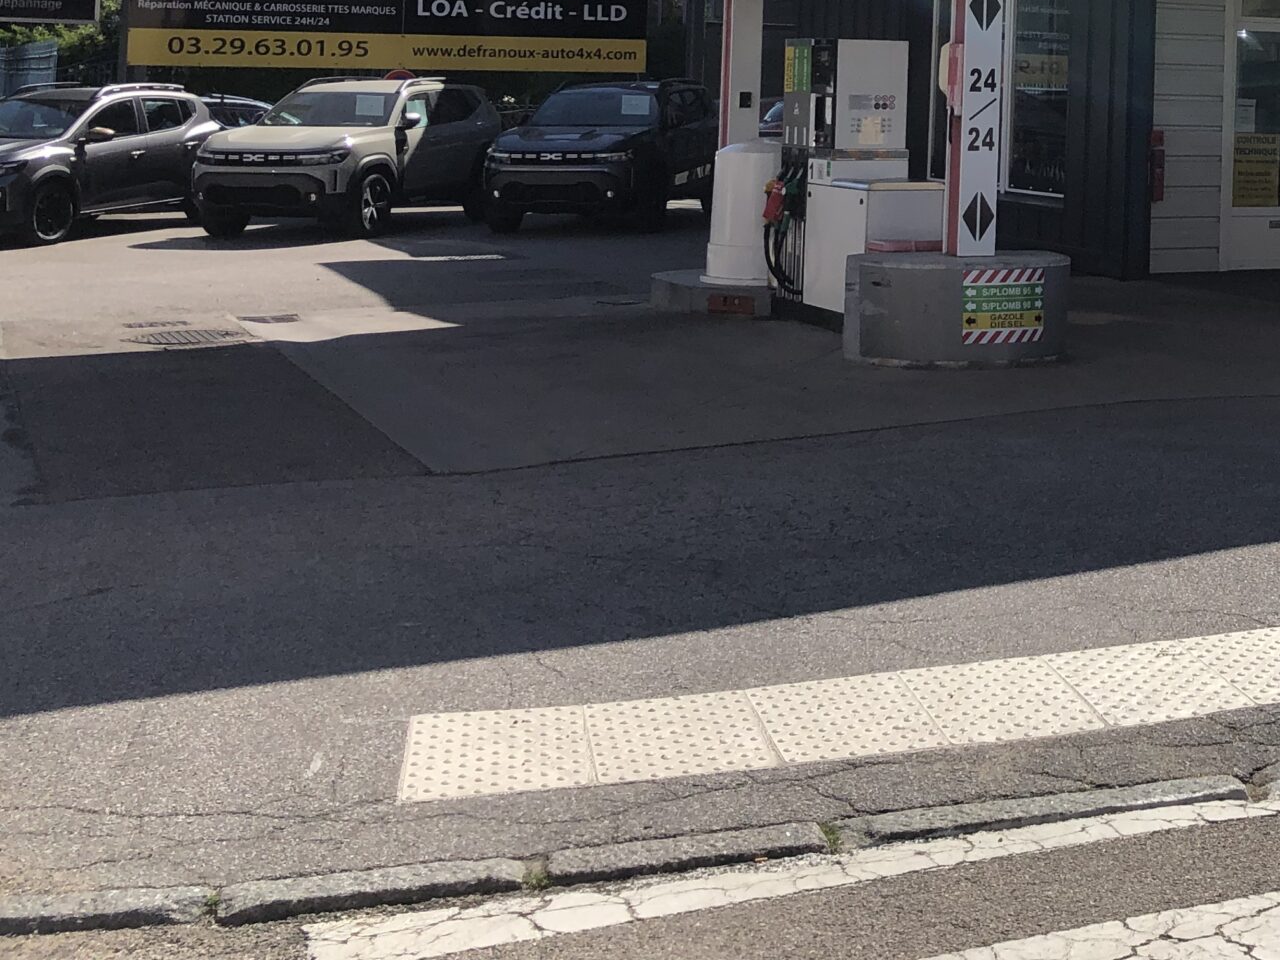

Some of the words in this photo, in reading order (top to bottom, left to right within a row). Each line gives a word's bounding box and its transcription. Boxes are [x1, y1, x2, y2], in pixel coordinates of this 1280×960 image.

[138, 0, 192, 12] Réparation
[254, 3, 261, 11] &
[263, 3, 326, 14] CARROSSERIE
[327, 5, 349, 15] TTES
[351, 5, 397, 17] MARQUES
[417, 0, 469, 18] LOA
[489, 0, 563, 20] Crédit
[583, 4, 628, 22] LLD
[205, 14, 249, 24] STATION
[251, 15, 293, 25] SERVICE
[294, 16, 330, 26] 24H/24
[167, 36, 370, 57] 03.29.63.01.95
[412, 44, 637, 61] www.defranoux-auto4x4.com
[969, 68, 997, 93] 24
[967, 127, 995, 151] 24
[981, 286, 1021, 296] S/PLOMB
[981, 301, 1021, 310] S/PLOMB
[990, 313, 1025, 321] GAZOLE
[990, 320, 1025, 329] DIESEL
